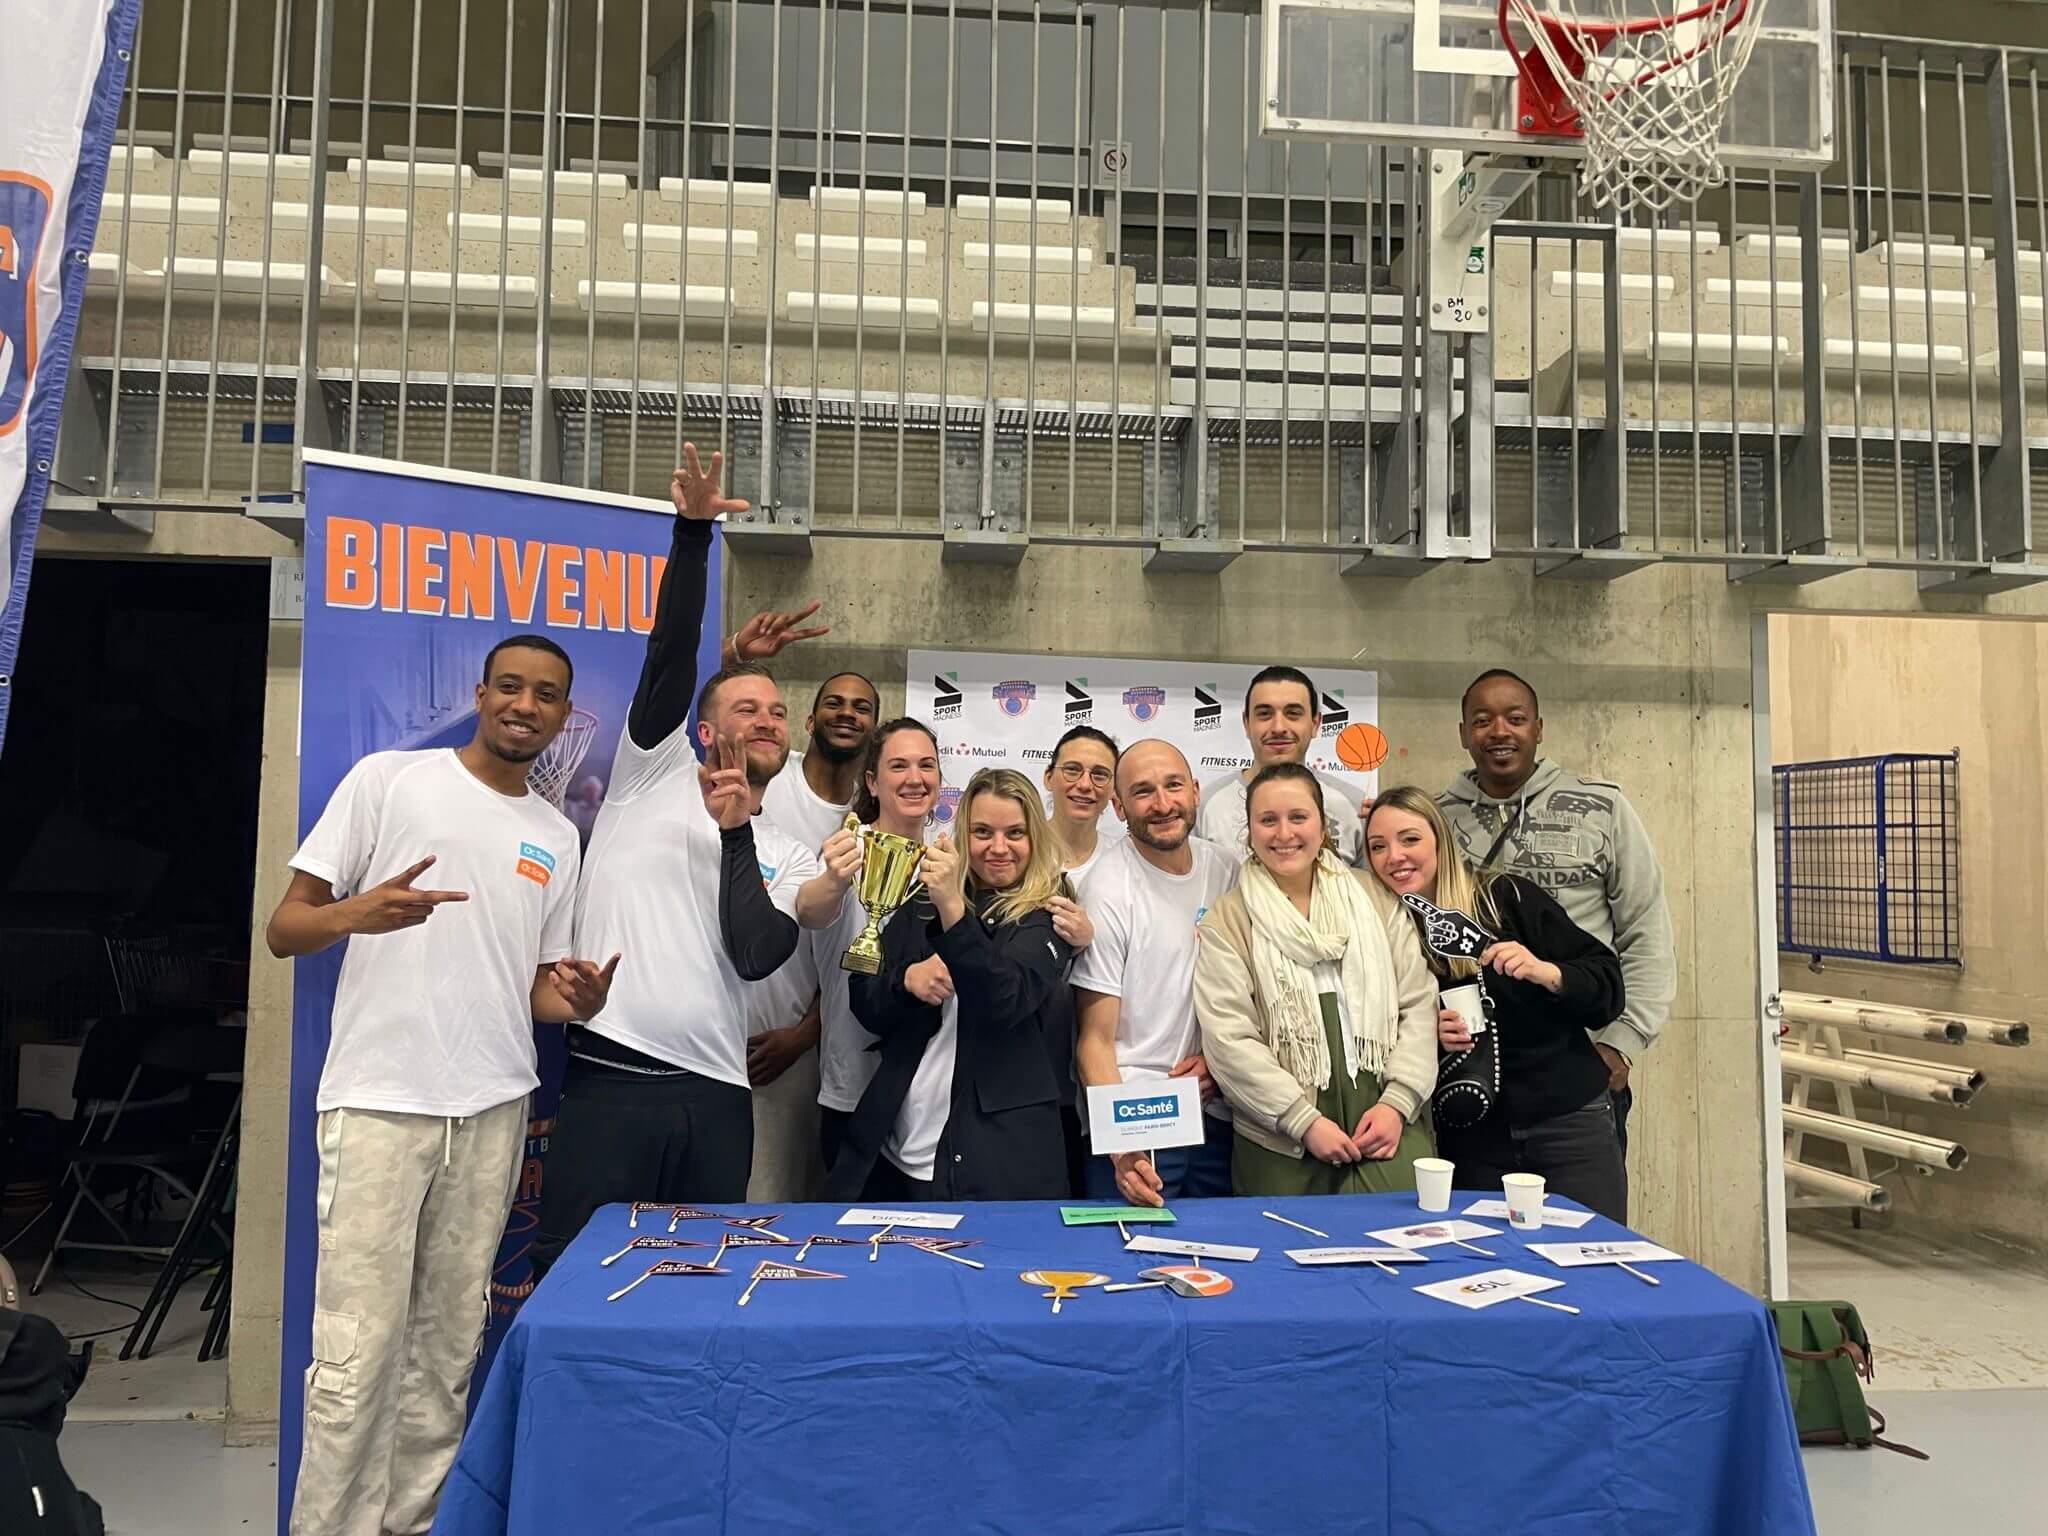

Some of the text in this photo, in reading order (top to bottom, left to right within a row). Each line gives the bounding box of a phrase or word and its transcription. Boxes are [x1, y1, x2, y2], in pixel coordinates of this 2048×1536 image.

[1454, 309, 1472, 322] 20
[325, 516, 669, 635] BIENVENU
[933, 705, 962, 716] SPORT
[1064, 710, 1092, 721] SPORT
[933, 713, 962, 721] MADNESS
[1193, 715, 1221, 727] SPORT
[1321, 722, 1348, 733] SPORT
[939, 747, 1007, 757] dit Mutuel
[1022, 750, 1054, 759] FITNES
[1200, 757, 1254, 767] FITNESS PA
[1328, 762, 1351, 771] Mut
[1460, 926, 1482, 954] #1
